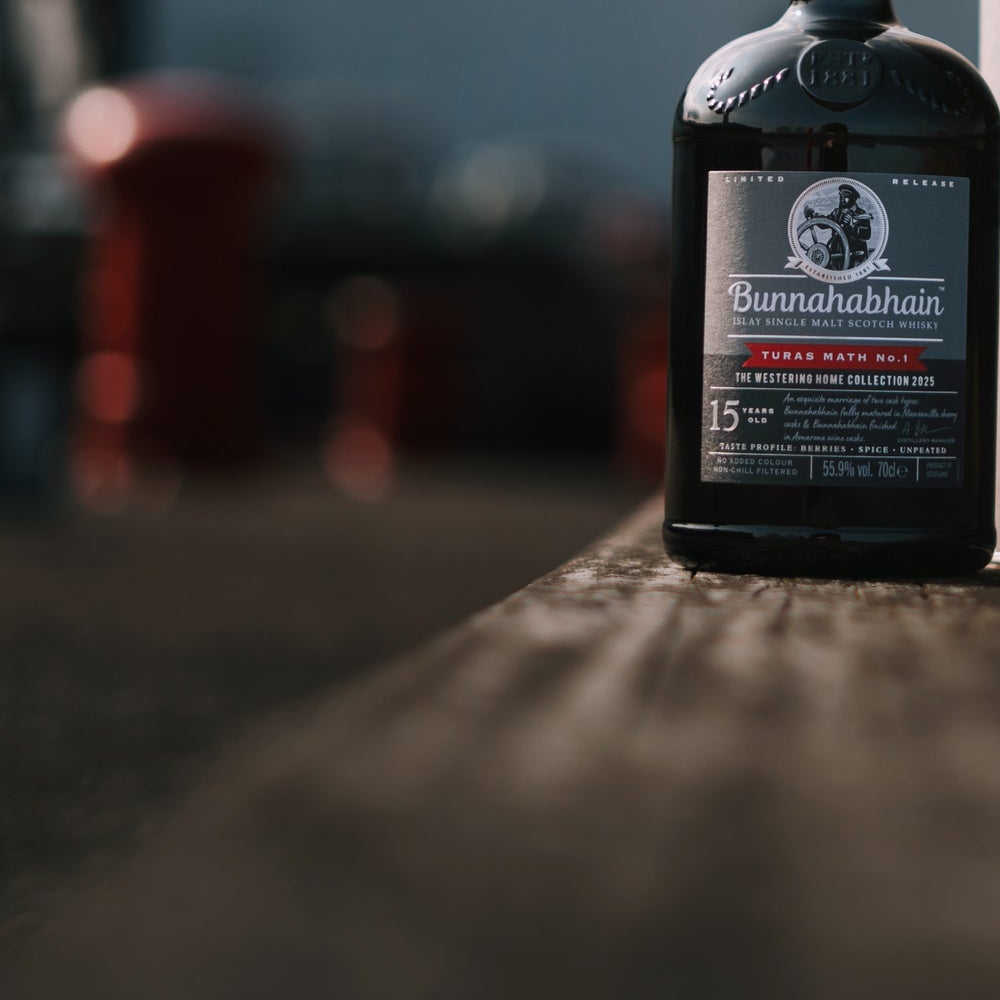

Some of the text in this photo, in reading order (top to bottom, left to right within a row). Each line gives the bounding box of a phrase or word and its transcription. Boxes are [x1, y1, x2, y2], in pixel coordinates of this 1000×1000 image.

[724, 175, 955, 188] LIMITED RELEASE
[804, 264, 853, 281] ESTABLISHED
[727, 280, 945, 317] Bunnahabhain
[732, 317, 940, 331] ISLAY SINGLE MALT SCOTCH WHISKY
[761, 350, 909, 363] TURAS MATH No.1
[735, 372, 936, 387] THE WESTERING HOME COLLECTION 2025
[710, 399, 740, 432] 15
[742, 407, 776, 415] YEARS
[747, 416, 768, 424] OLD
[719, 442, 748, 451] TASTE
[800, 444, 847, 453] BERRIES
[858, 446, 889, 454] SPICE
[900, 446, 948, 455] UNPEATED
[730, 457, 755, 465] ADDED
[757, 458, 793, 466] COLOUR
[713, 466, 754, 475] NON-CHILL
[823, 460, 855, 477] 55.9%
[857, 460, 873, 477] vol.
